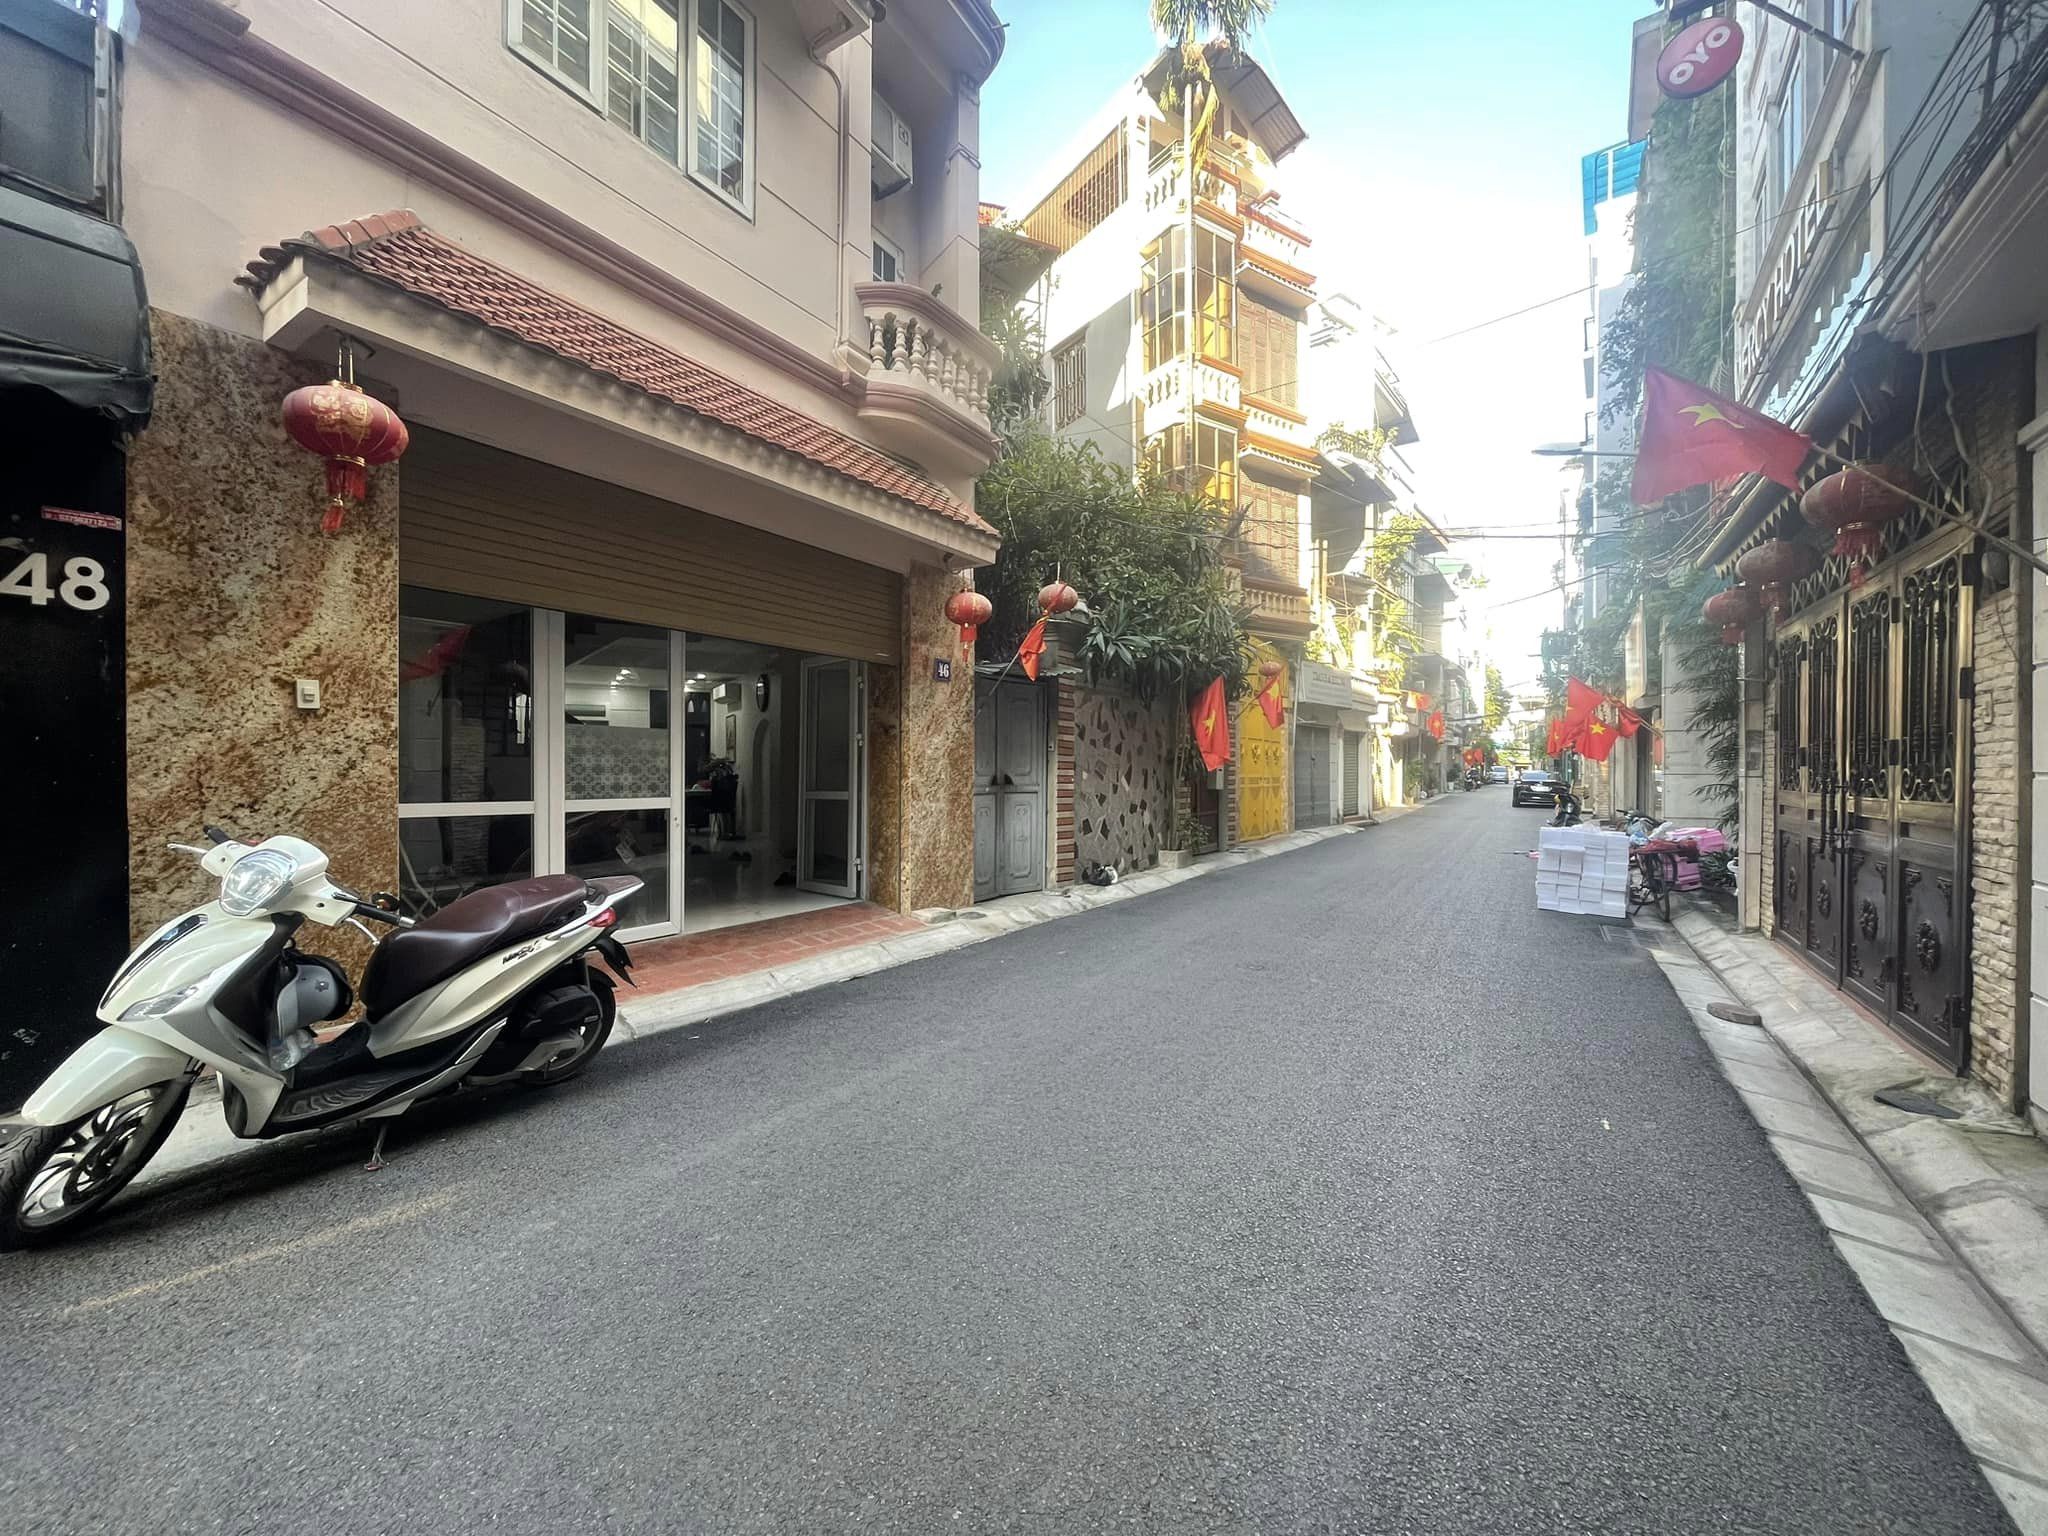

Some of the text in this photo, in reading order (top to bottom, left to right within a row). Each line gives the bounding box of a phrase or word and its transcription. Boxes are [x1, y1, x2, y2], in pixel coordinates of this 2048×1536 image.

[1669, 25, 1731, 85] OYO
[1774, 160, 1828, 321] HOTEL
[0, 552, 110, 611] 48
[938, 662, 949, 678] 46
